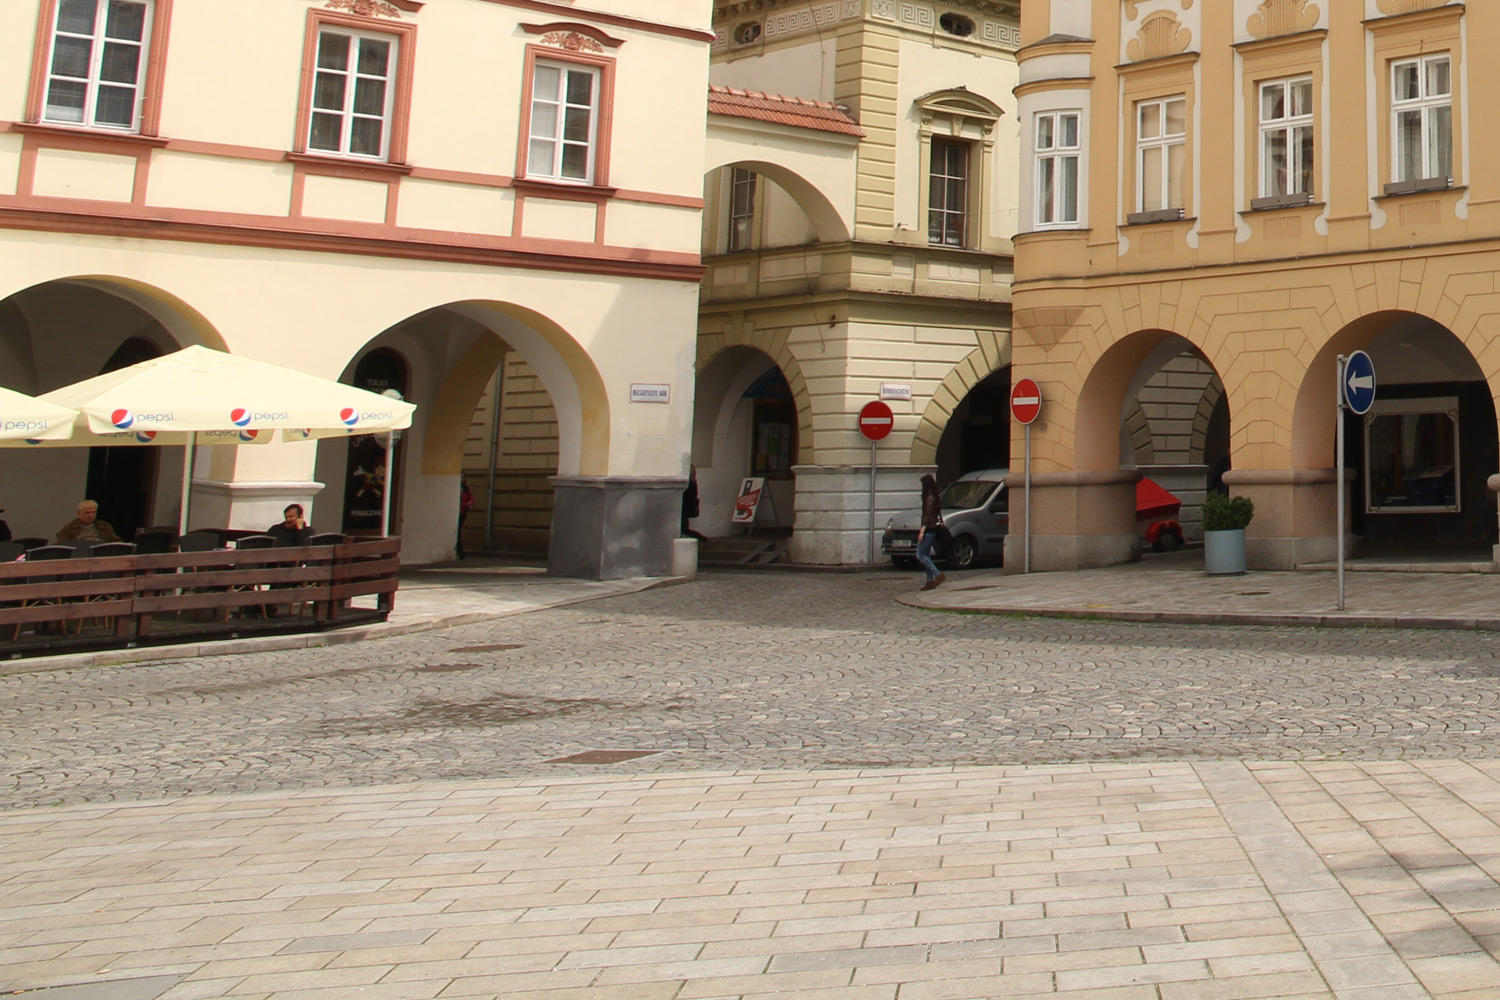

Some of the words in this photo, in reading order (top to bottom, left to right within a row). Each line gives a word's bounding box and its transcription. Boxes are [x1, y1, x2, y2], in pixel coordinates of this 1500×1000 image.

[137, 412, 175, 423] pepsi
[254, 411, 290, 421] pepsi
[361, 411, 394, 421] pepsi
[5, 420, 48, 431] pepsi
